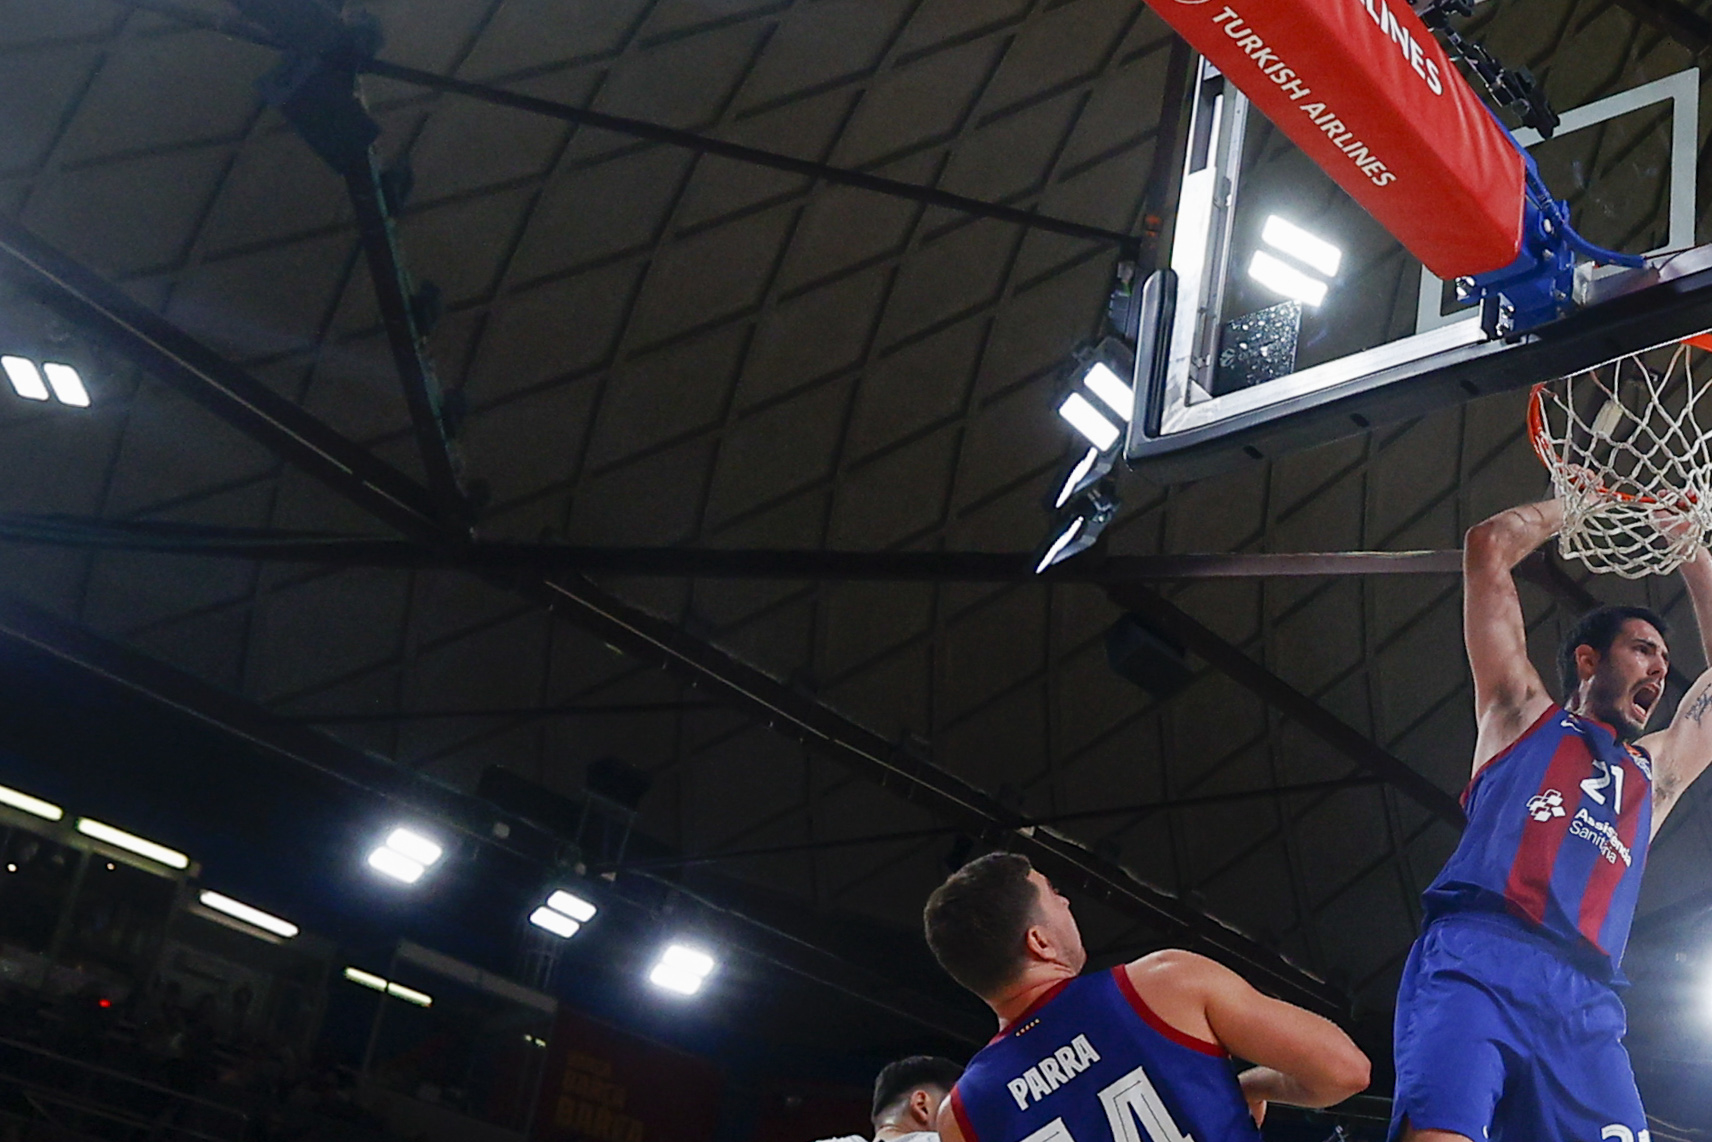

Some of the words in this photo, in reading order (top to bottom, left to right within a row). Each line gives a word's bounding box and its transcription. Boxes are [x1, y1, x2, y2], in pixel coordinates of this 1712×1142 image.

[1212, 7, 1311, 101] TURKISH
[1300, 101, 1397, 187] AIRLINES
[1580, 759, 1624, 815] 21
[1007, 1033, 1101, 1112] PARRA
